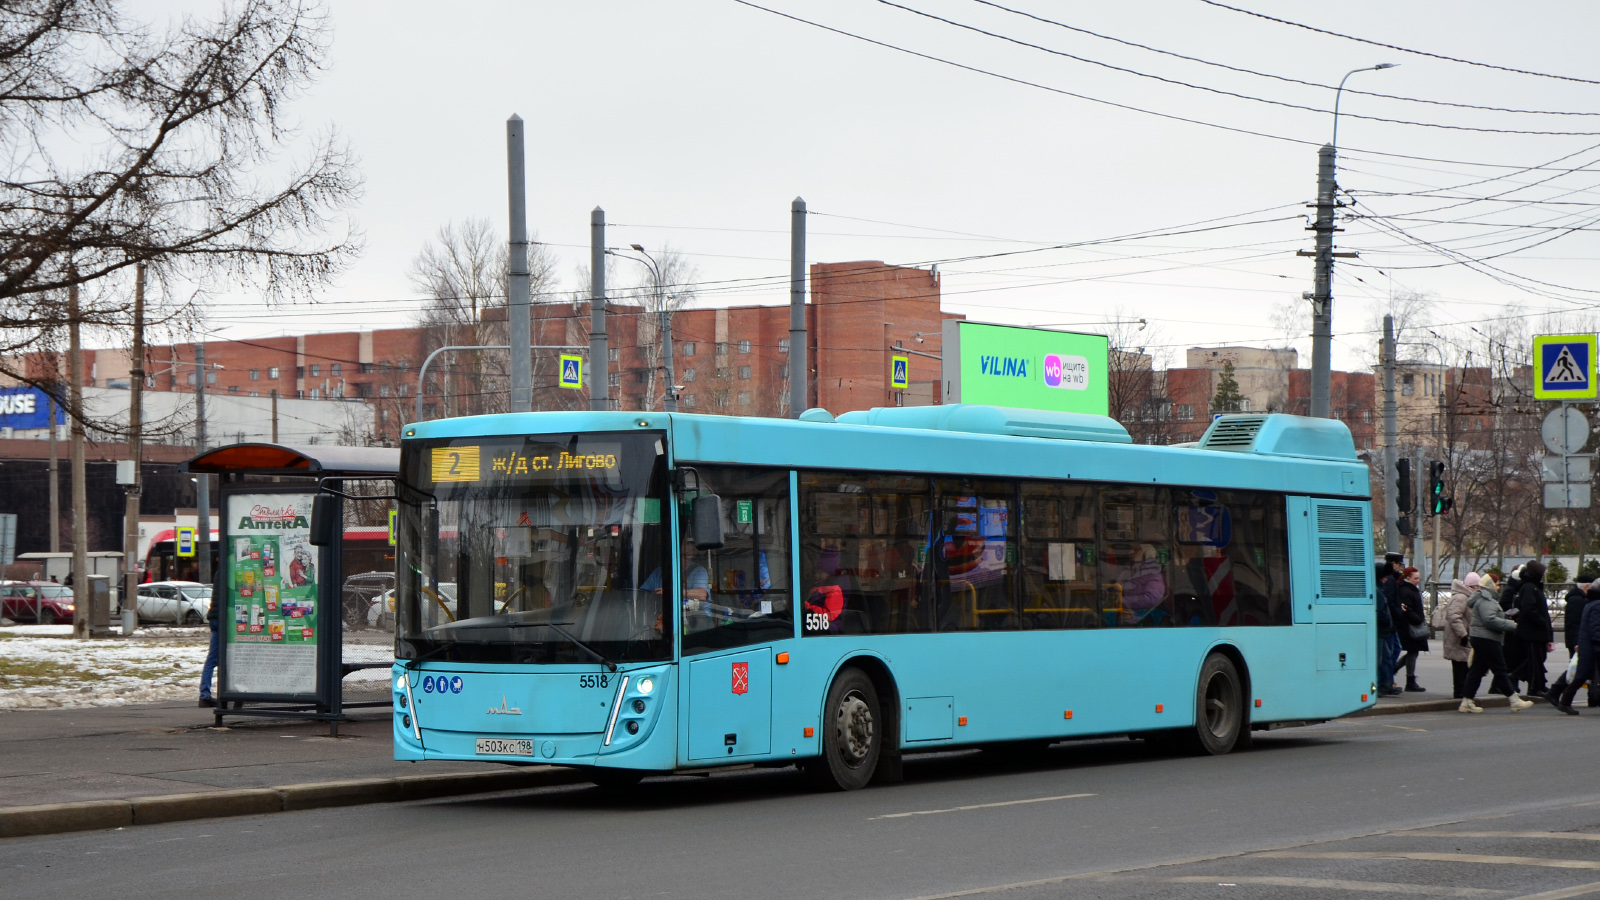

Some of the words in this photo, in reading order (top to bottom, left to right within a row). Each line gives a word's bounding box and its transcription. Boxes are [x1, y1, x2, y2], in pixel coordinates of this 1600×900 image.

[981, 355, 1027, 377] VILINA
[1045, 362, 1060, 377] wb
[1062, 362, 1085, 372] ищите
[1062, 374, 1071, 383] на
[1073, 373, 1084, 383] wb
[449, 452, 460, 475] 2
[492, 451, 528, 475] ж/д
[532, 456, 553, 471] ст.
[557, 451, 616, 470] Лигово
[806, 612, 830, 631] 5518
[579, 674, 609, 688] 5518
[517, 740, 531, 750] 198
